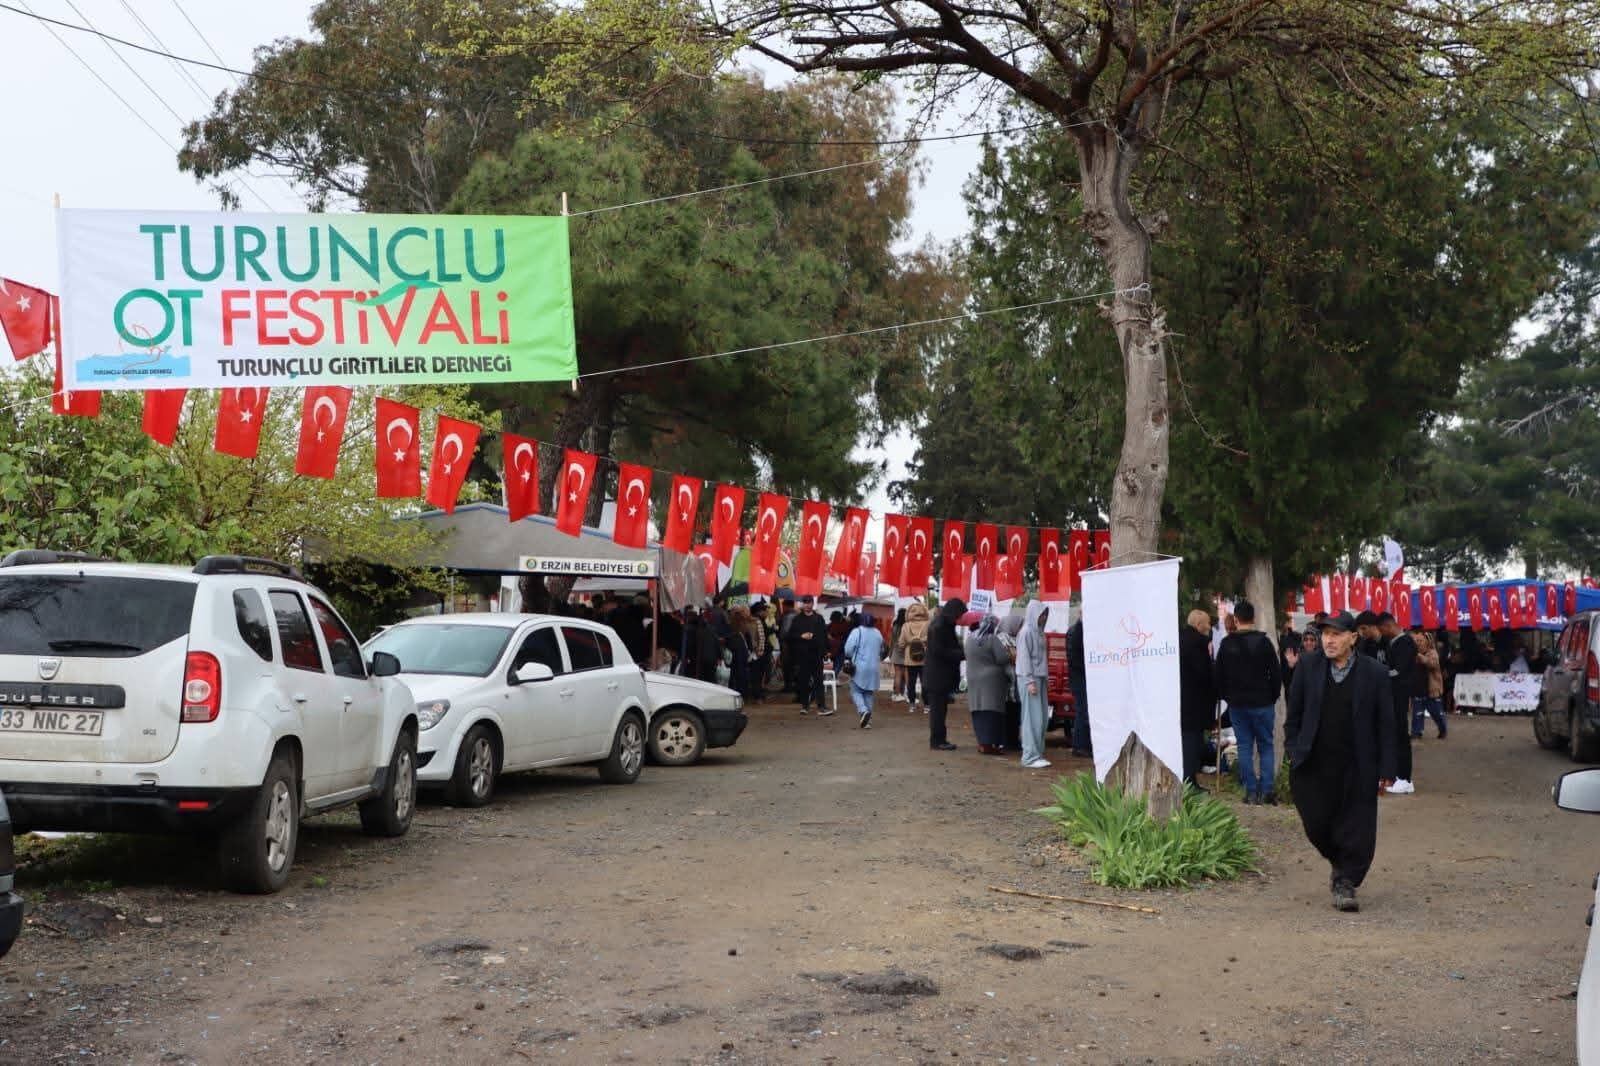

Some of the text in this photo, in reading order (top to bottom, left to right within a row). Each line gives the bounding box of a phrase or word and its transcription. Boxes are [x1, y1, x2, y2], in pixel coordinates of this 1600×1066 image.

[140, 223, 506, 286] TURUNÇLU
[114, 288, 203, 347] OT
[218, 357, 323, 379] TURUNÇLU
[1, 710, 100, 732] 33 NNC 27
